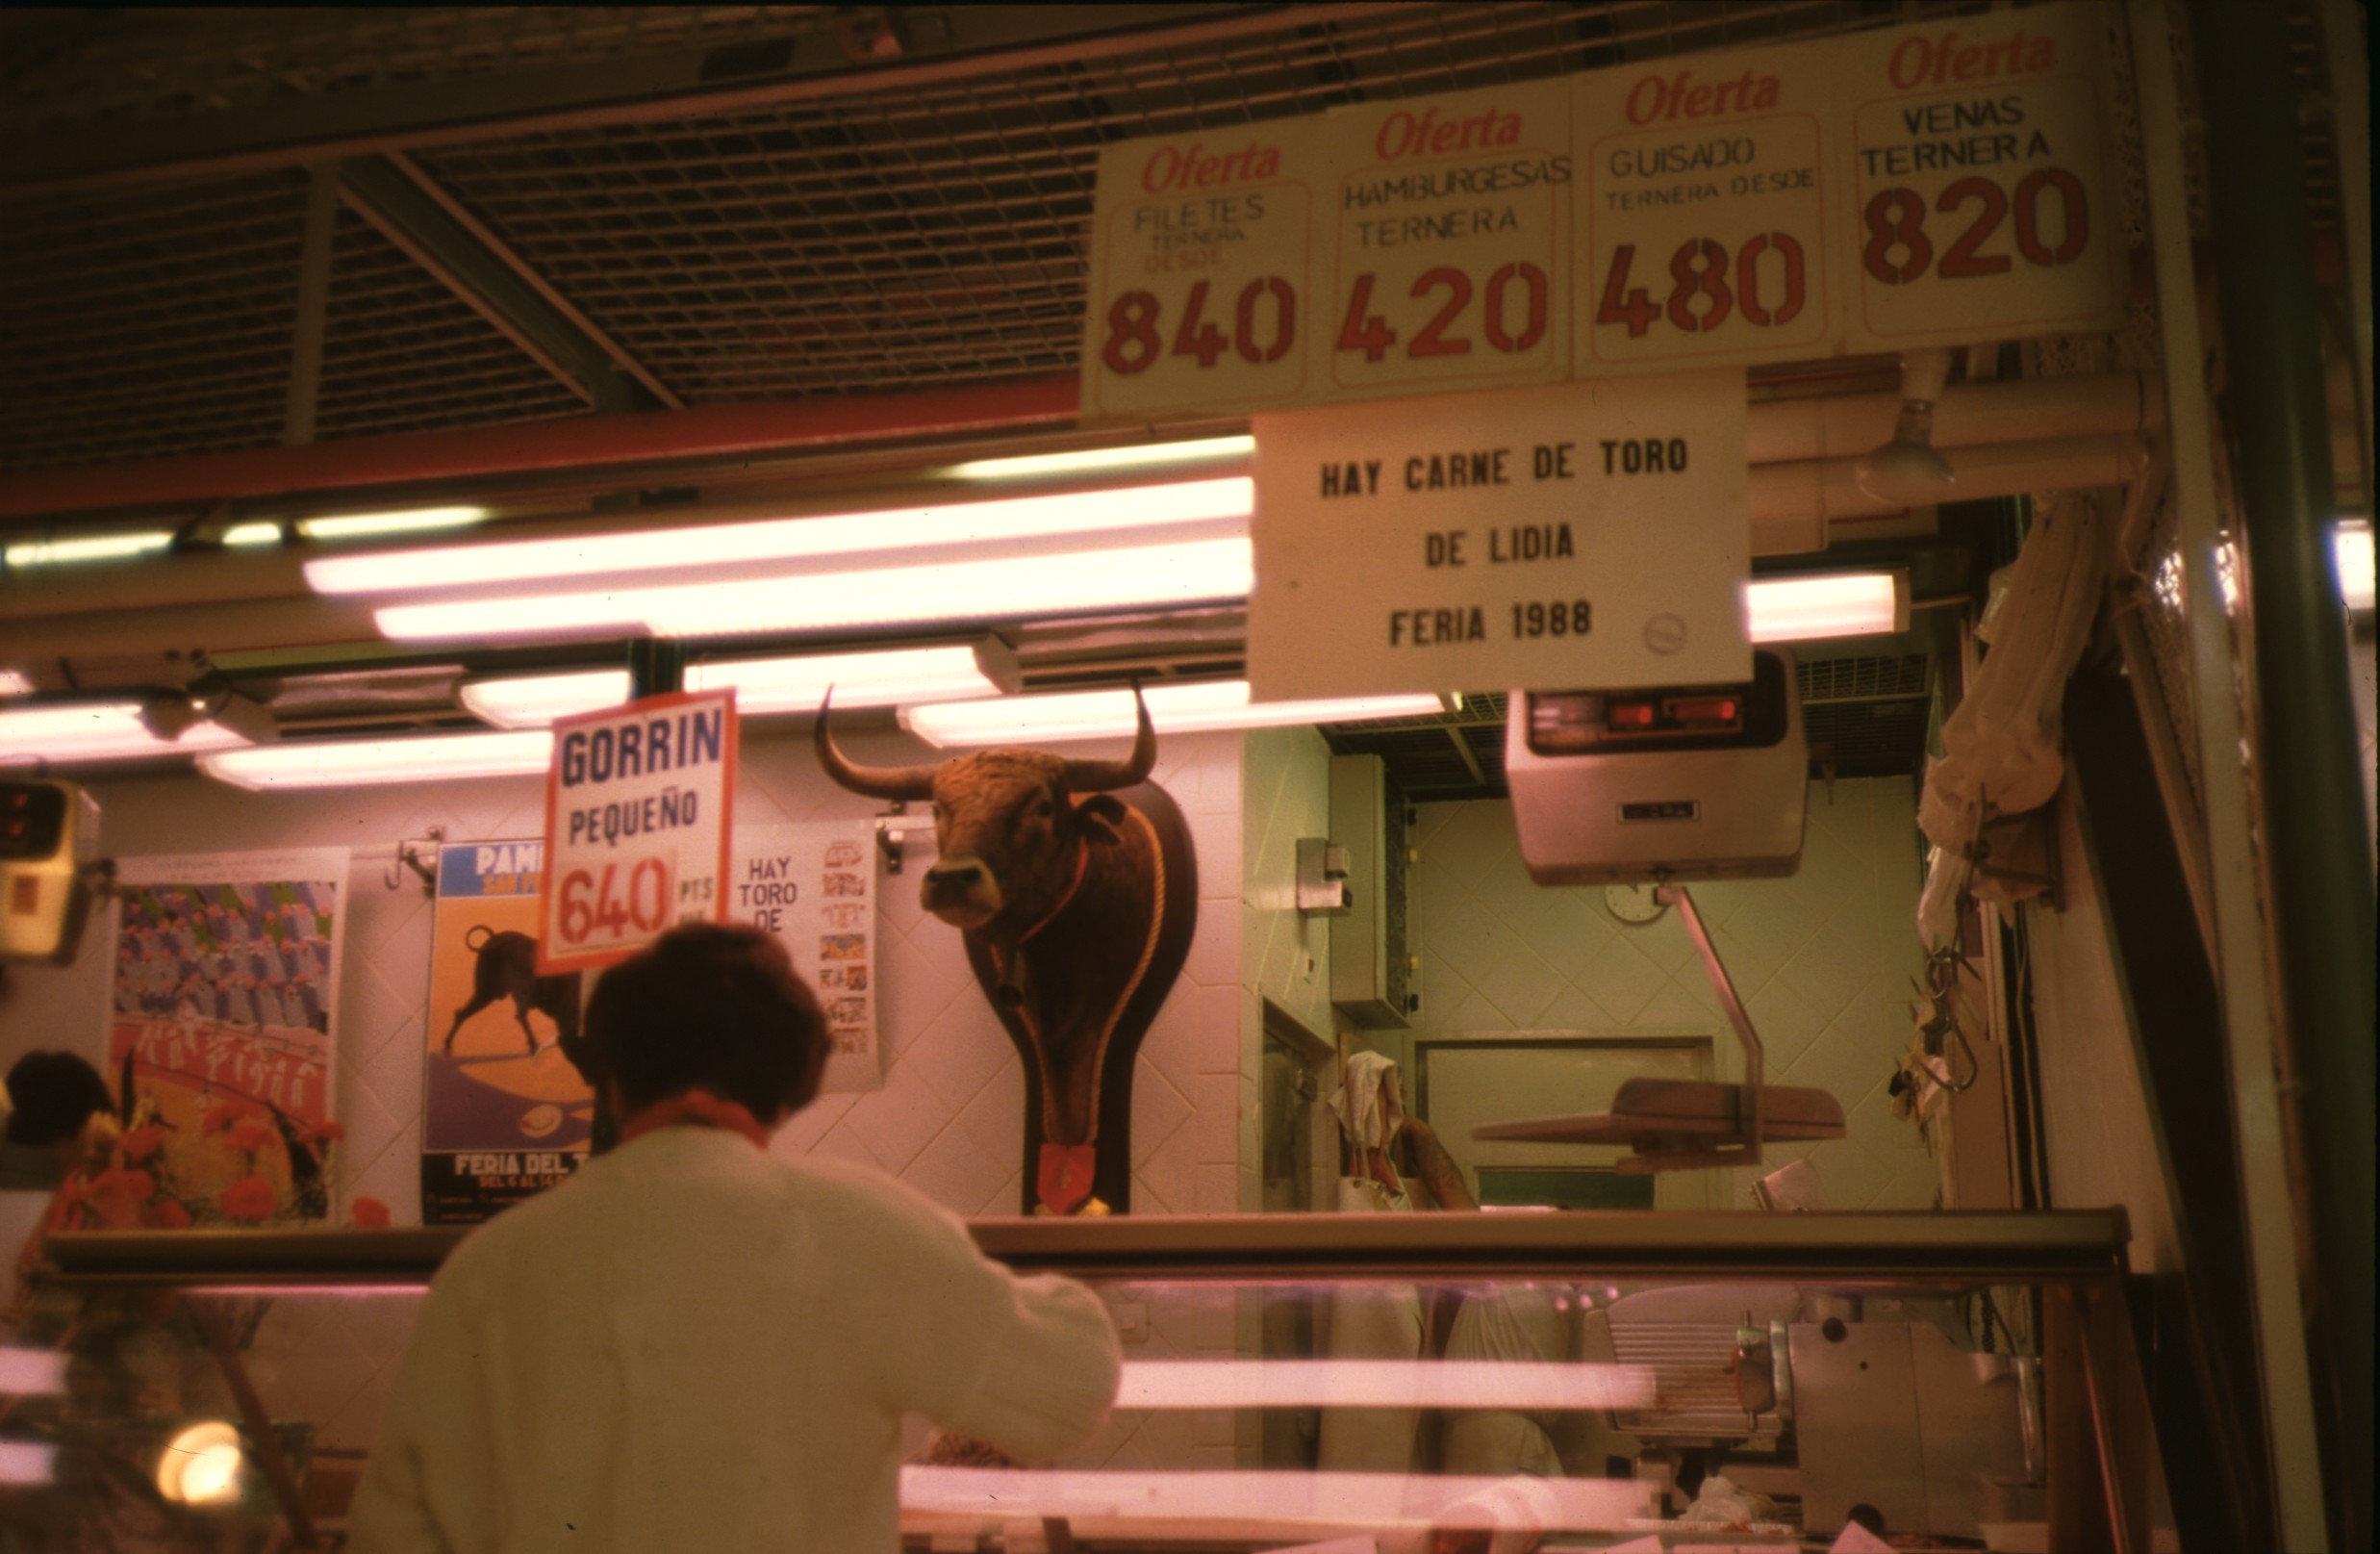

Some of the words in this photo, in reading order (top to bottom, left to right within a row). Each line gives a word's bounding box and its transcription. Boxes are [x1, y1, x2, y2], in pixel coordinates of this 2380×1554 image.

[1888, 33, 2057, 90] Oferta
[1625, 69, 1781, 126] Oferta
[1902, 97, 2024, 136] VENAS
[1375, 107, 1523, 162] Oferta
[1609, 138, 1755, 178] GUISADO
[1861, 130, 2051, 178] TERNERA
[1142, 142, 1281, 192] Oferta
[1345, 155, 1572, 210] HAMBURGESAS
[1606, 183, 1719, 211] TERNERA
[1731, 167, 1815, 196] DESDE
[1133, 193, 1265, 233] FILETES
[1356, 206, 1518, 249] TERNERA
[1863, 166, 2089, 286] 820
[1152, 229, 1246, 251] TERNERA
[1596, 231, 1806, 339] 480
[1102, 276, 1296, 375] 840
[1336, 262, 1548, 363] 420
[1320, 460, 1381, 498] HAY
[1405, 448, 1511, 492] CARNE
[1533, 444, 1576, 480] DE
[1600, 438, 1688, 475] TORO
[1426, 531, 1468, 568] DE
[1489, 523, 1576, 563] LIDIA
[1389, 607, 1486, 647] FERIA
[1511, 599, 1592, 639] 1988
[562, 708, 722, 788] GORRIN
[569, 785, 697, 848] PEQUEÑO
[475, 845, 544, 875] PAM
[748, 855, 791, 880] HAY
[558, 856, 670, 944] 640
[679, 876, 714, 903] PTS
[739, 882, 798, 906] TORO
[753, 908, 783, 932] DE
[455, 1154, 520, 1176] FERIA
[525, 1153, 570, 1175] DEL
